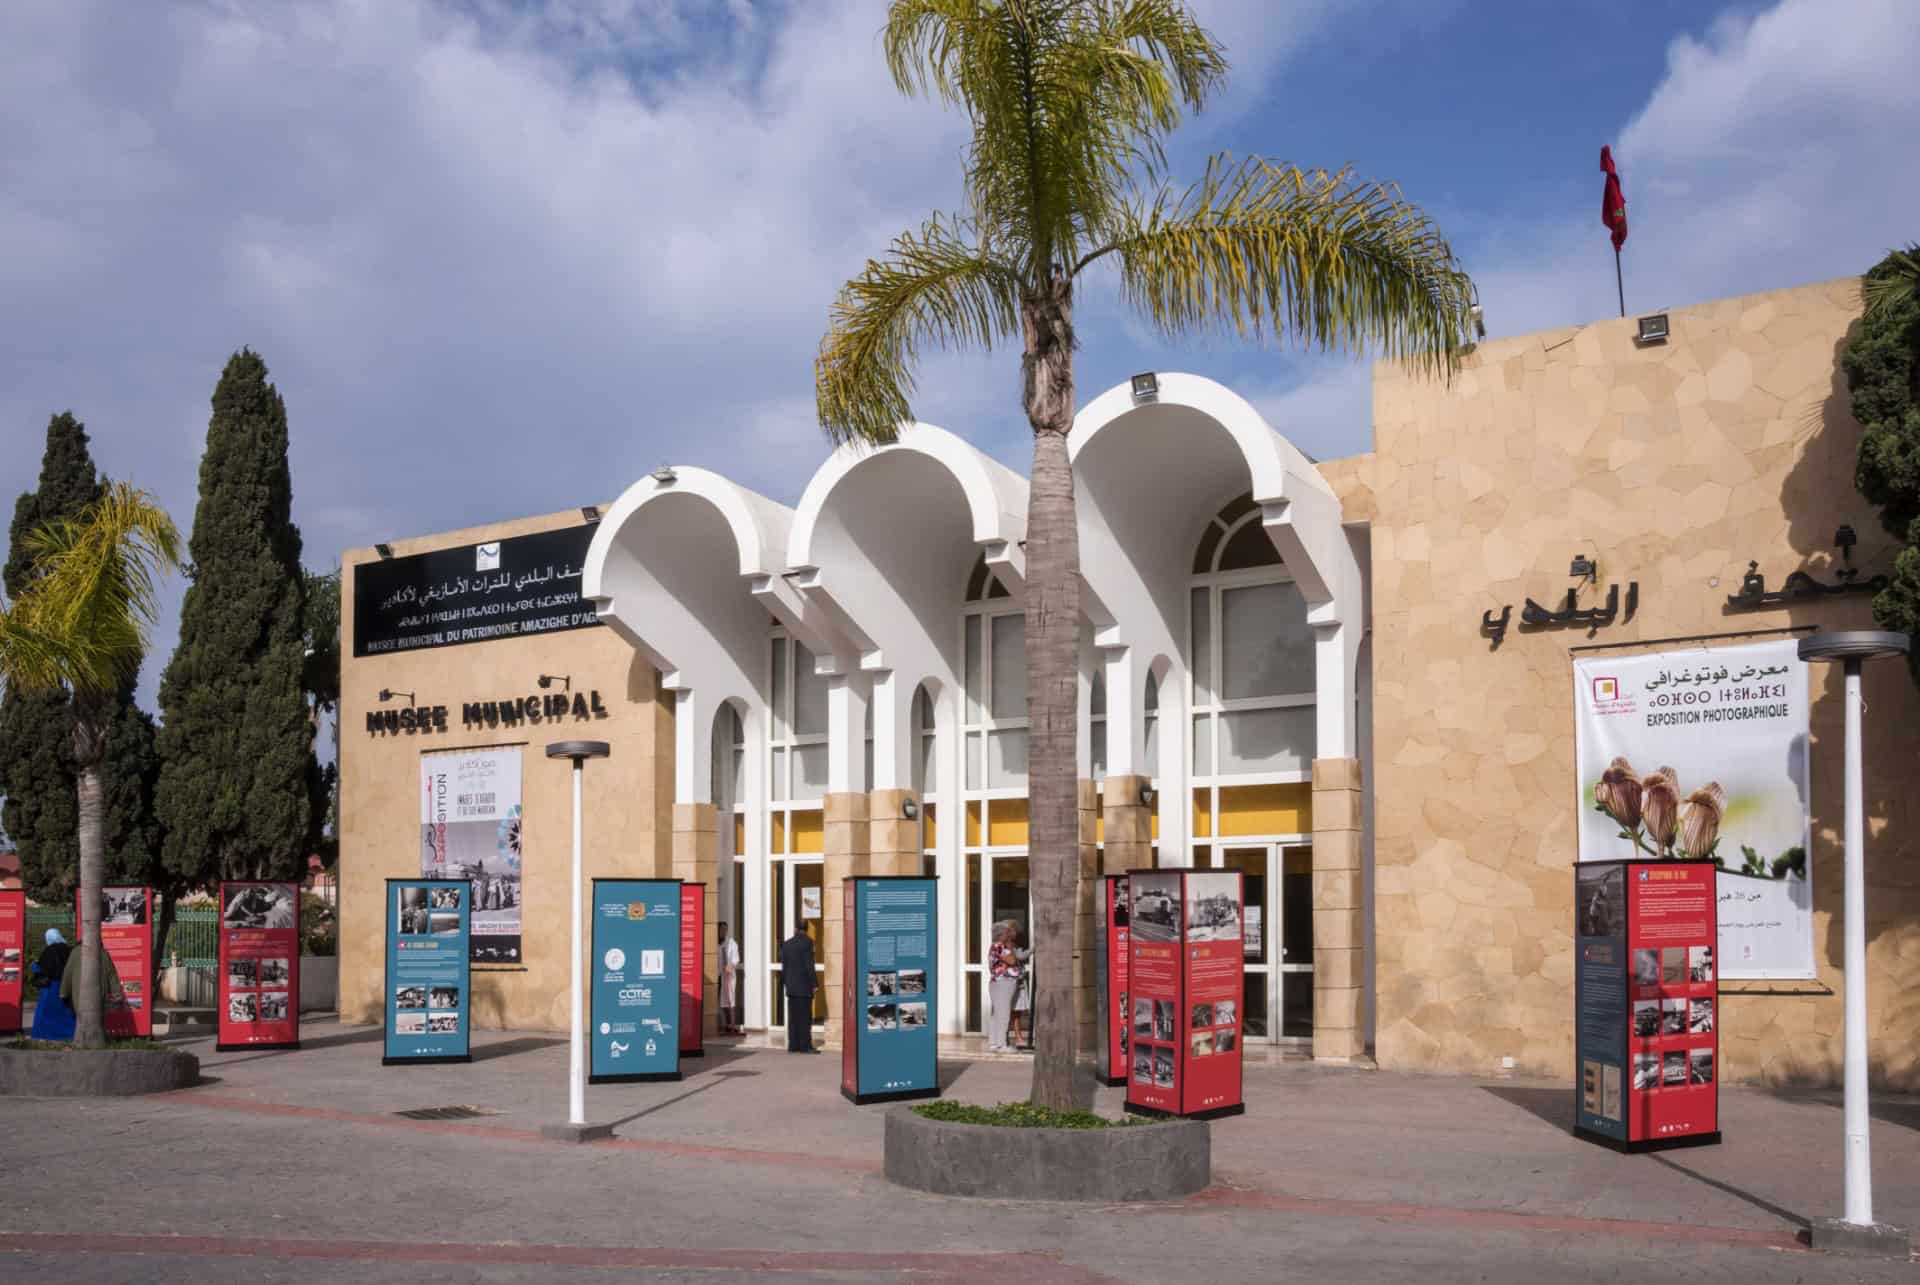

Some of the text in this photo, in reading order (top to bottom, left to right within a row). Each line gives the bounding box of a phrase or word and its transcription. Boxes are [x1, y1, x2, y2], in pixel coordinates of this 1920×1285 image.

[447, 629, 460, 643] DU
[462, 622, 518, 640] PATRIMOINE
[520, 615, 569, 632] AMAZIGHE
[1645, 665, 1789, 691] معرض فوتوغرافي
[366, 690, 606, 732] MUSEE MUNICIPAL
[1647, 703, 1789, 727] EXPOSITION PHOTOGRAPHIQUE
[435, 773, 447, 864] EXPOSITION
